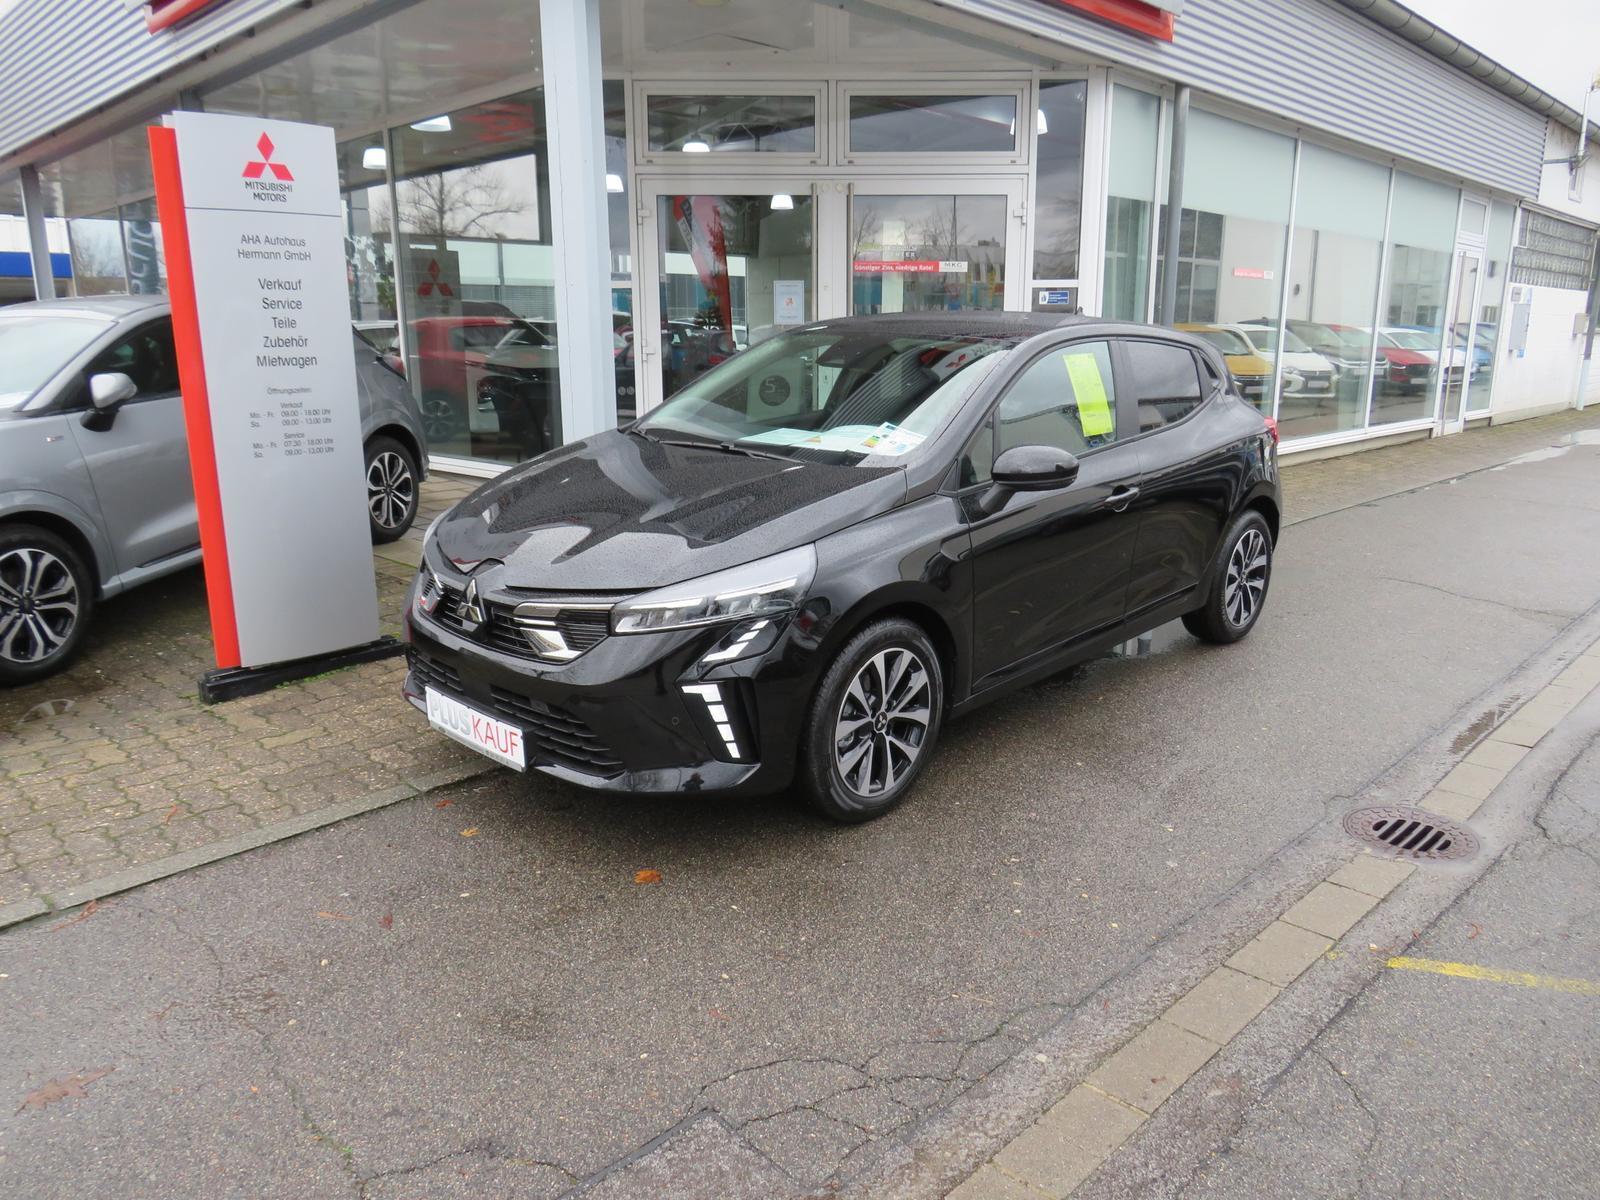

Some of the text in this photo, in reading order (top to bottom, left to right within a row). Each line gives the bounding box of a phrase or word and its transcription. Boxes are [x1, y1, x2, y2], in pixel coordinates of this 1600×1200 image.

[245, 181, 293, 193] MITSUBISHI
[253, 192, 287, 202] MOTORS
[240, 234, 306, 247] AHA Autohaus
[238, 249, 312, 261] Hermann GmbH
[854, 263, 880, 272] Günstiger
[257, 278, 302, 291] Verkauf
[262, 297, 303, 310] Service
[271, 316, 297, 329] Teile
[263, 335, 308, 348] Zubehör
[256, 355, 318, 369] Mietwagen
